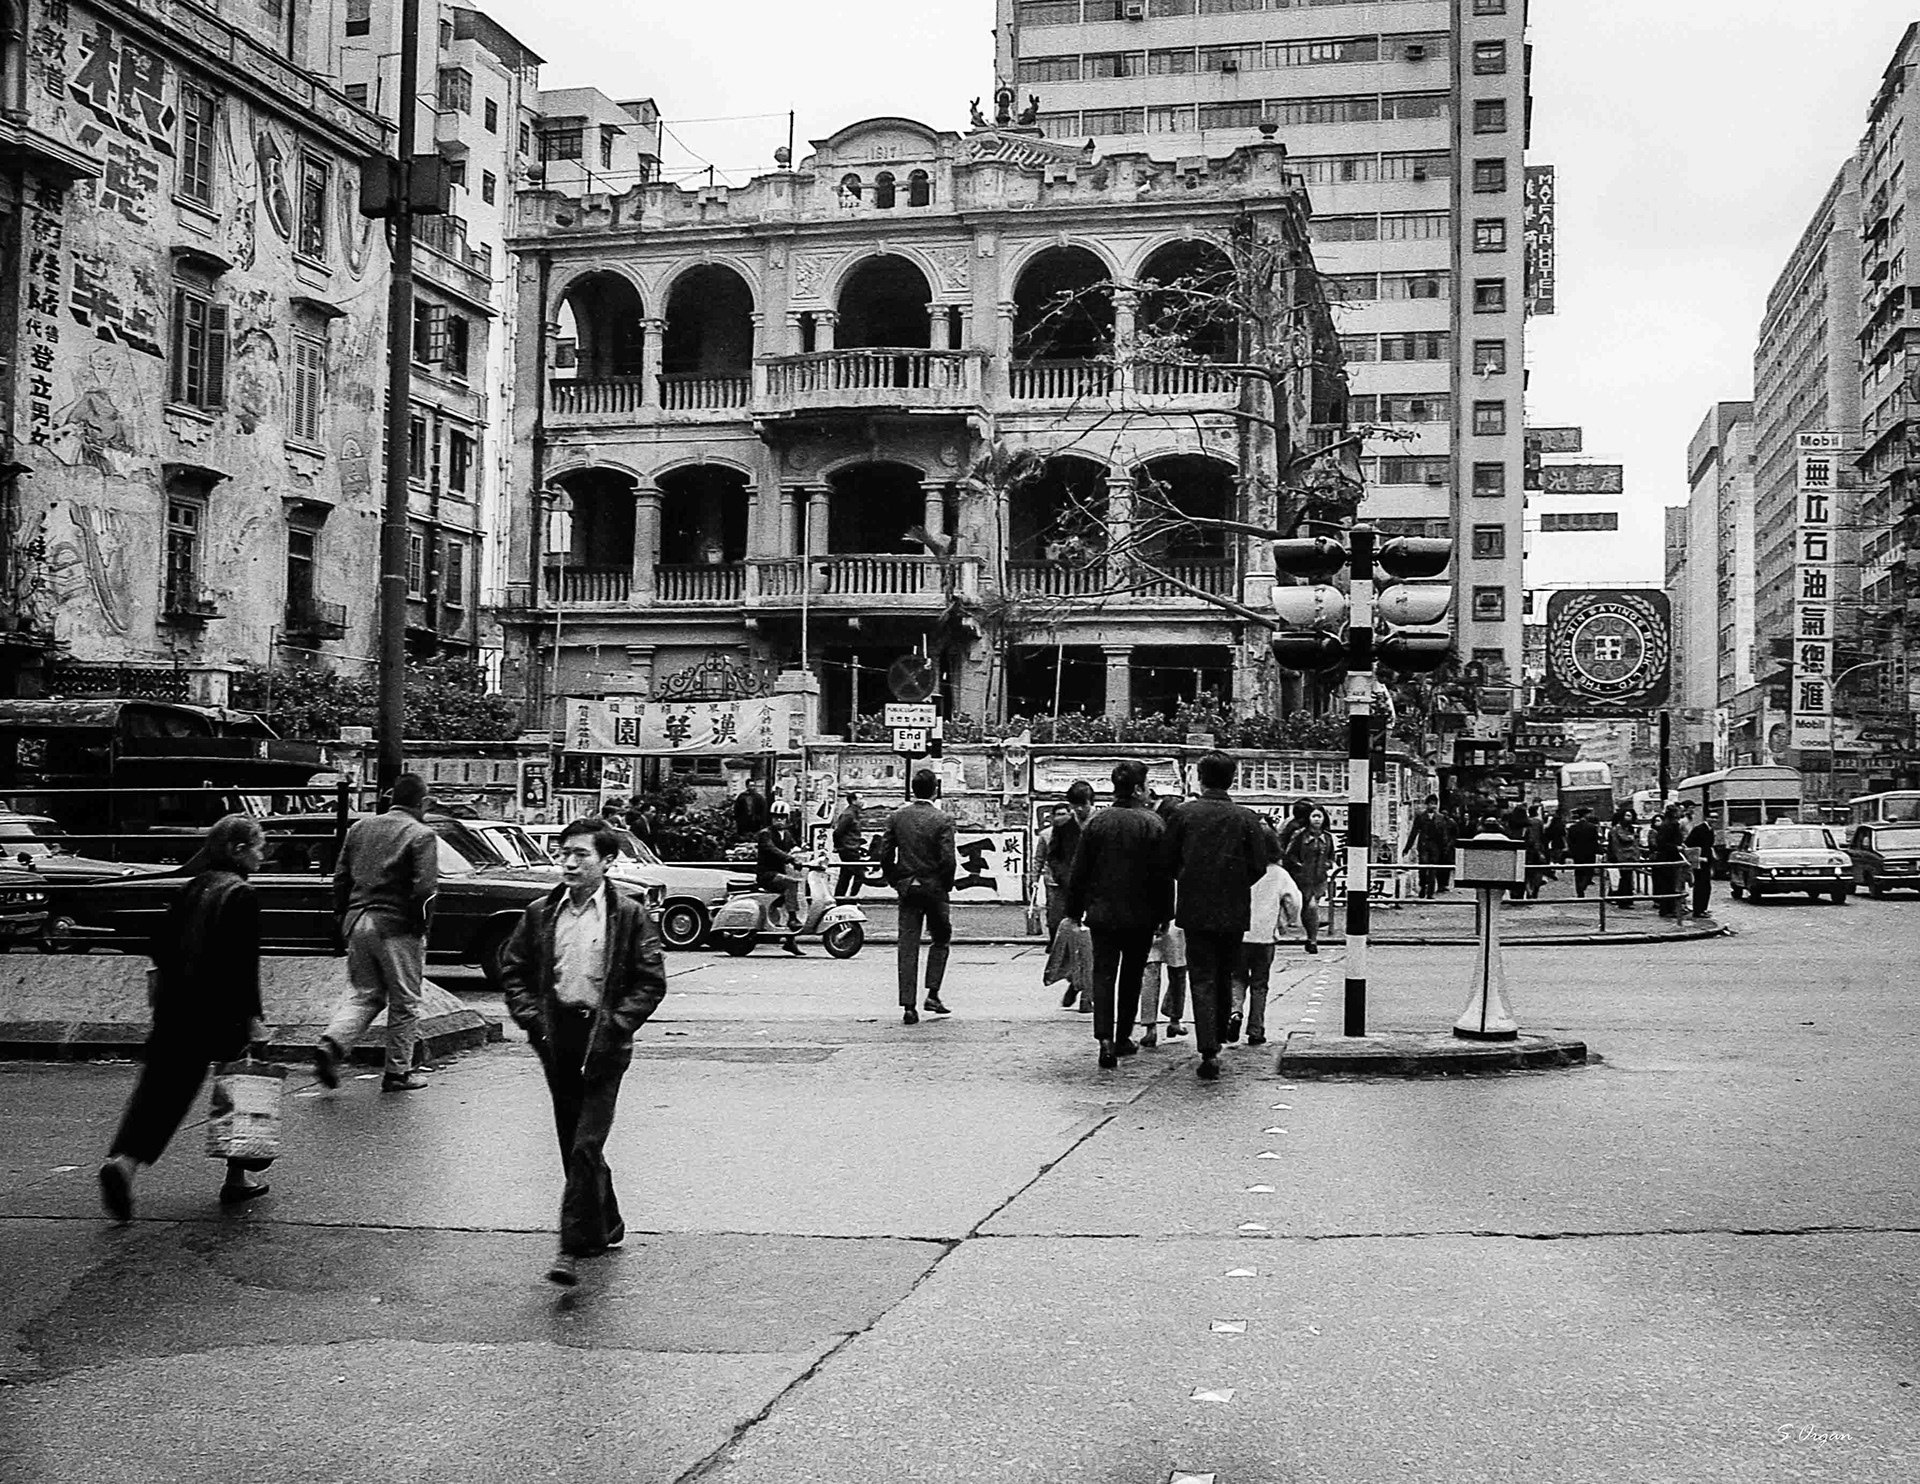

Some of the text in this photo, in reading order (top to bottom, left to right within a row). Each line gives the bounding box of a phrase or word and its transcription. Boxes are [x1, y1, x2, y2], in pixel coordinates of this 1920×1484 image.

[1538, 174, 1553, 299] MAYFAIR HOTEL
[1801, 435, 1839, 446] Mobil
[1568, 614, 1586, 636] NIN
[1588, 605, 1646, 627] SAVINGS
[1579, 677, 1602, 691] THE
[614, 713, 738, 748] 漢華園
[1795, 719, 1825, 729] Mobil
[899, 731, 921, 740] End
[1002, 836, 1023, 874] 跌打
